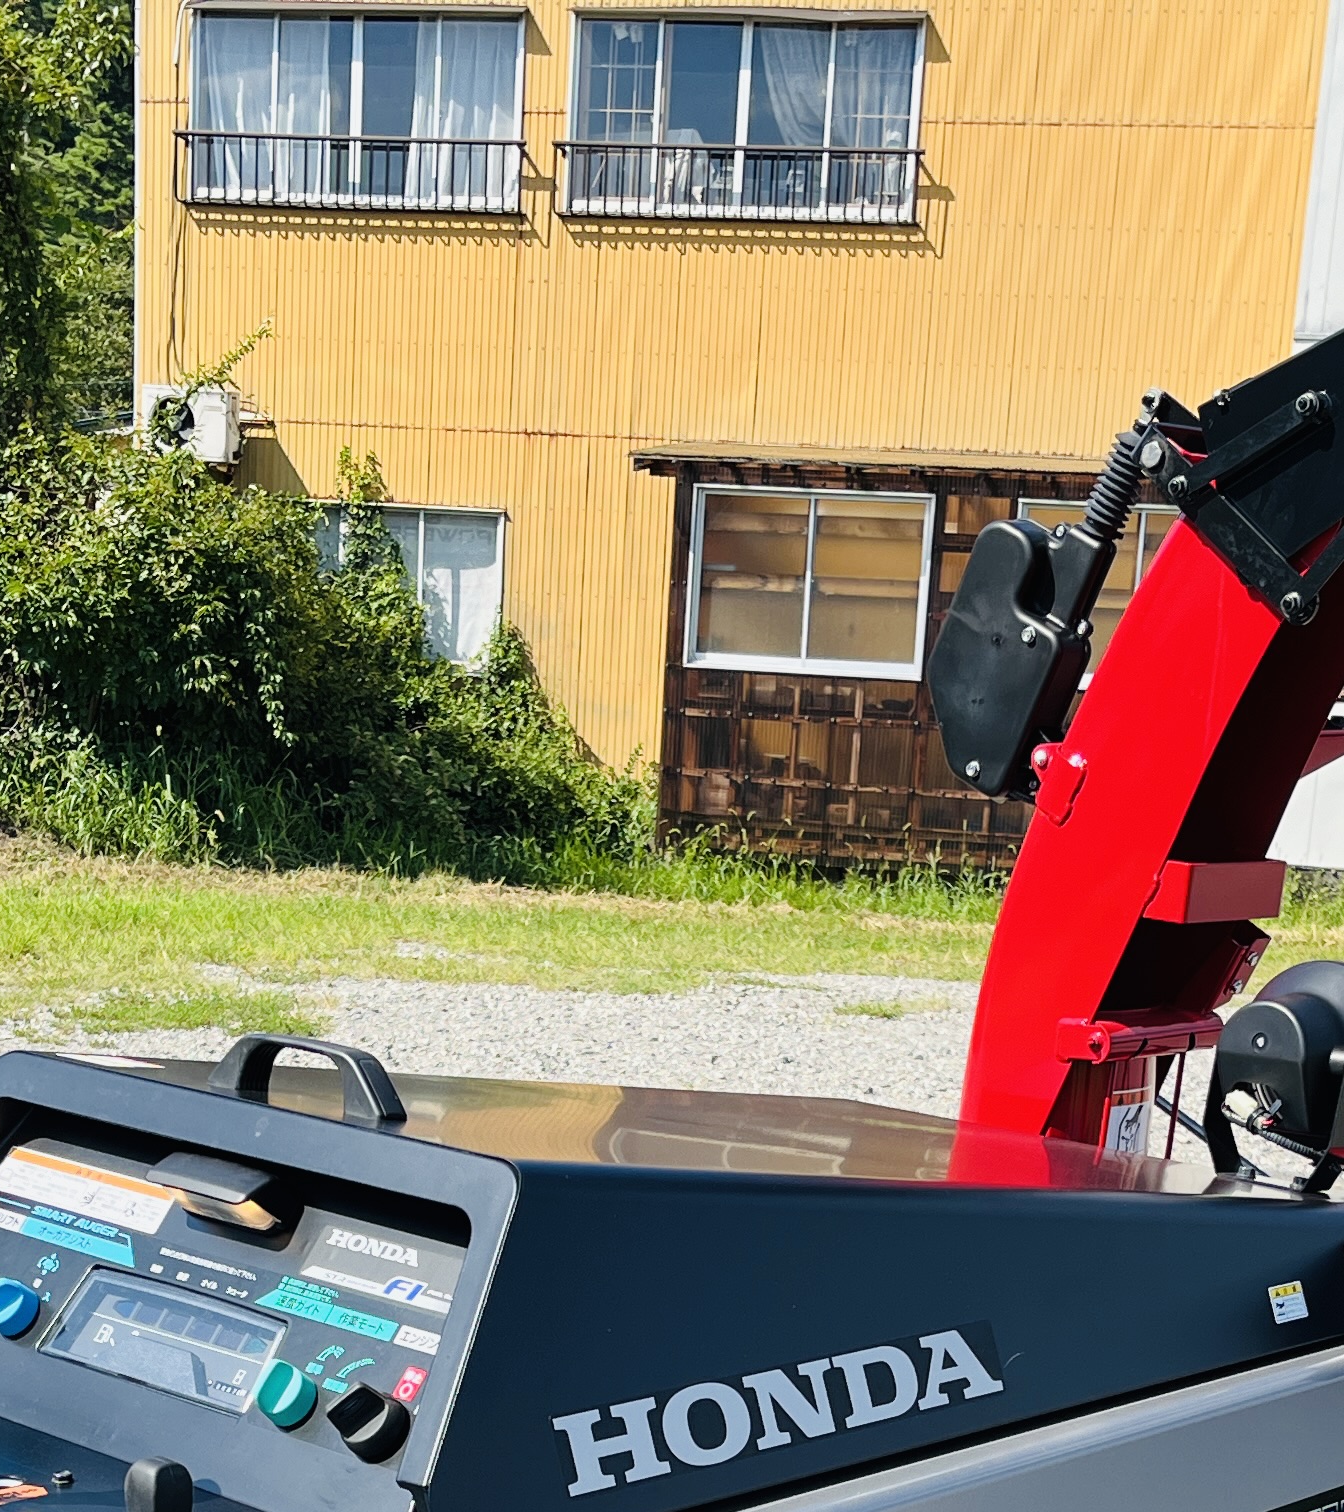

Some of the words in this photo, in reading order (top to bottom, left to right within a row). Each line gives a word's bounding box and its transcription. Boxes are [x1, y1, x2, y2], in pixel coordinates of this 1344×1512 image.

[31, 1205, 76, 1226] SMART
[75, 1218, 119, 1238] AUGER
[326, 1228, 419, 1268] HONDA
[553, 1329, 1004, 1499] HONDA
